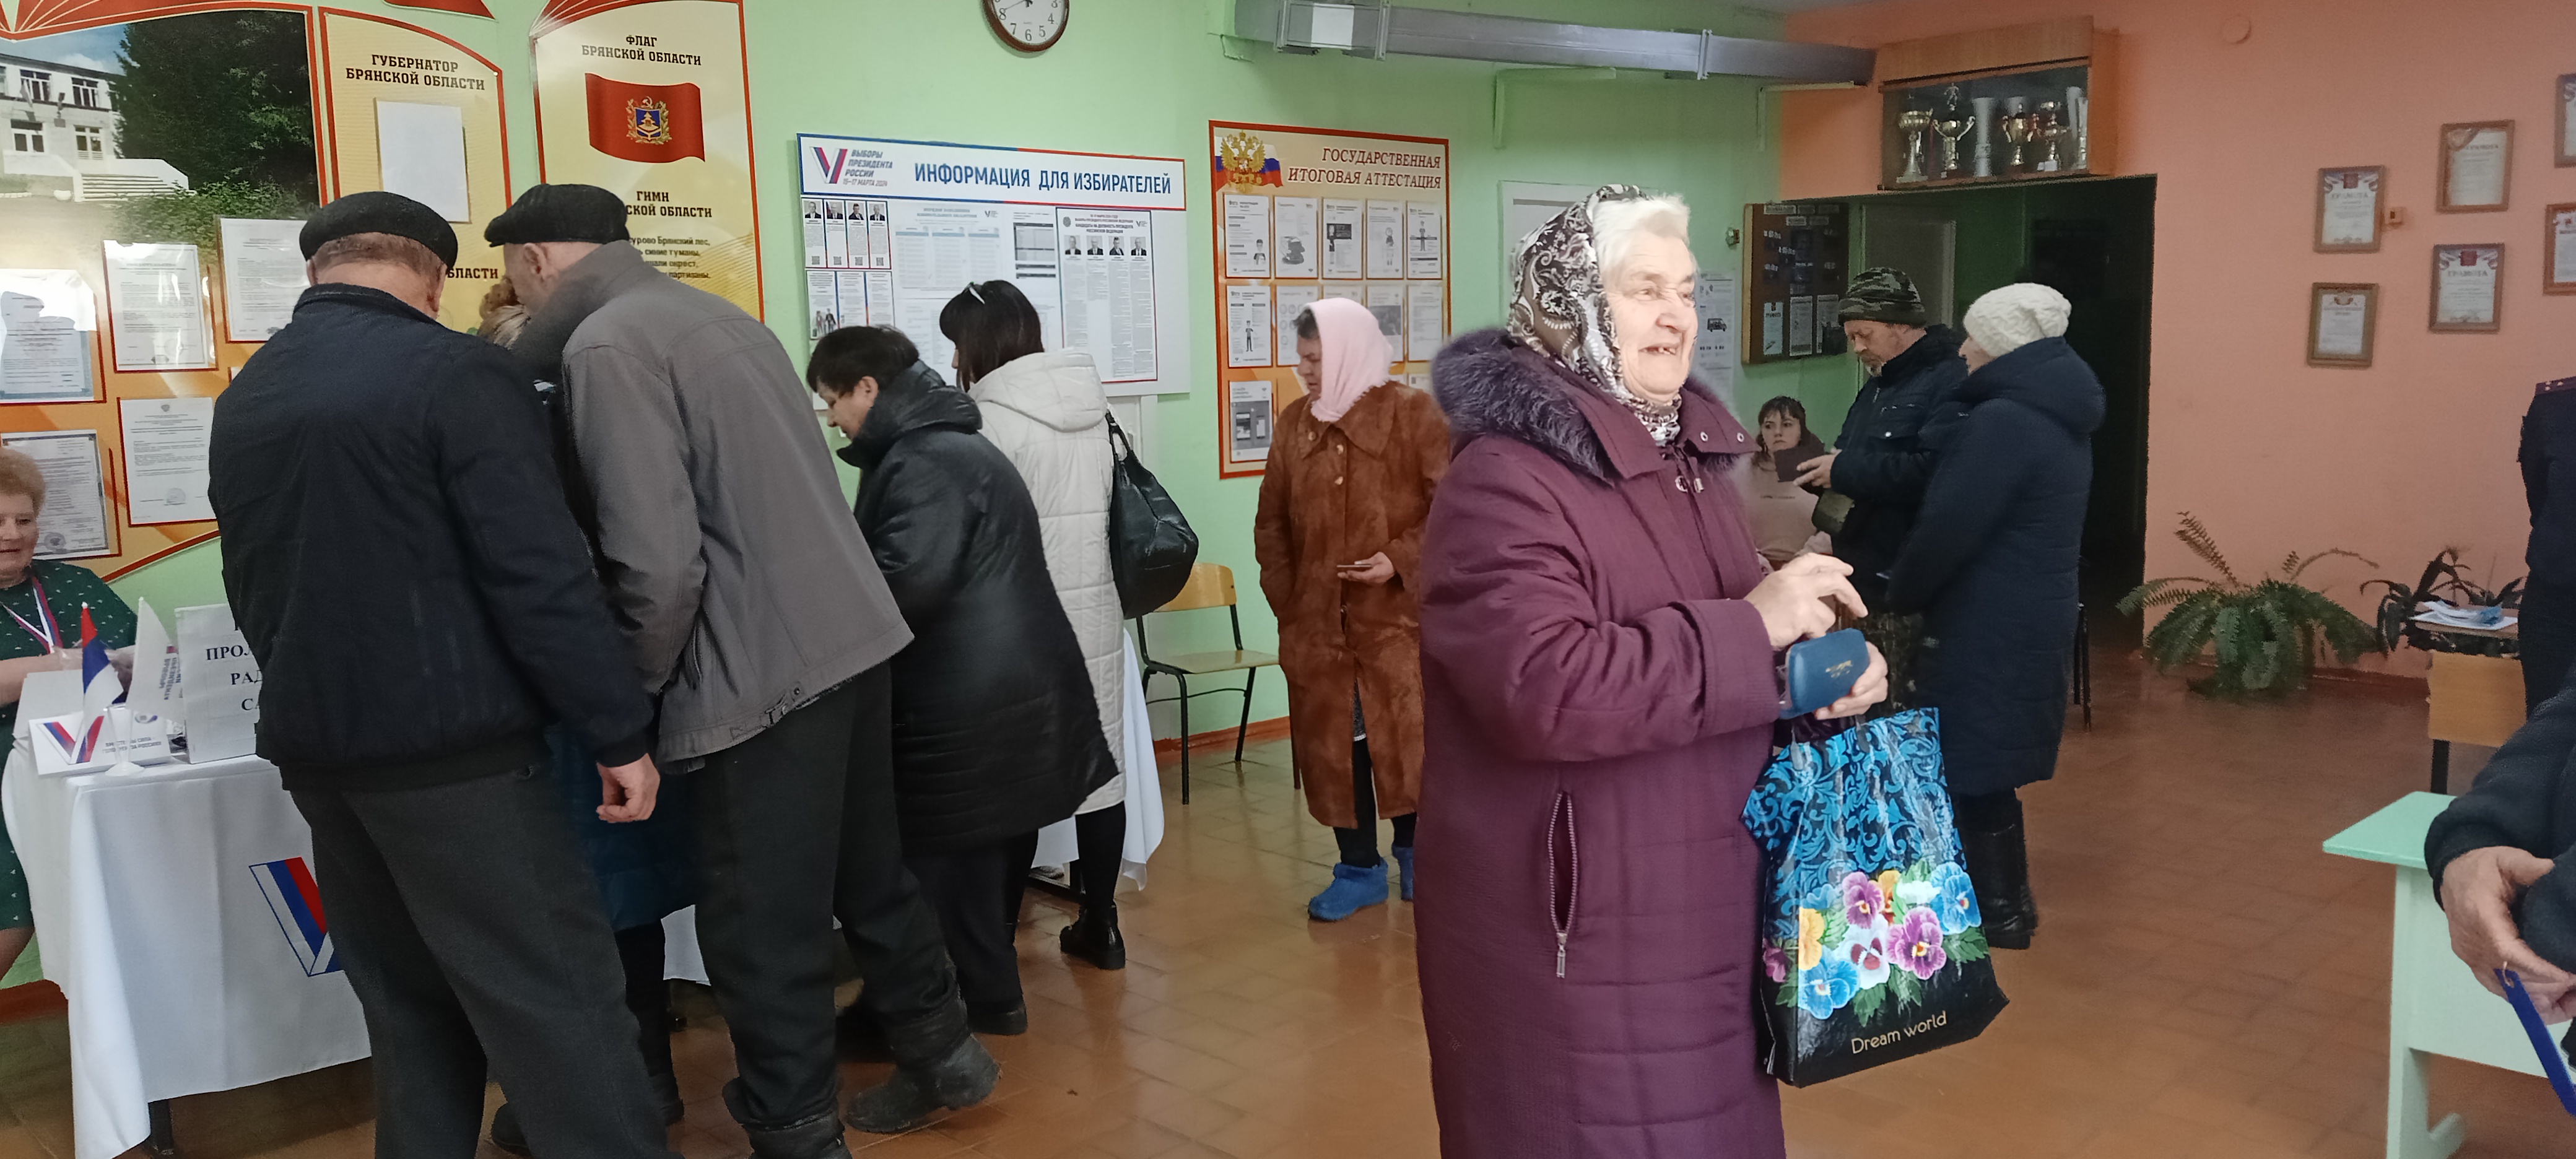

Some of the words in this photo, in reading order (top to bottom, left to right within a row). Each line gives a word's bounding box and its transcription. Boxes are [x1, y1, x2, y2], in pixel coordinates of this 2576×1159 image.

[999, 7, 1006, 20] 8
[1047, 12, 1055, 24] 4
[1010, 22, 1017, 35] 7
[1025, 28, 1032, 41] 6
[1039, 25, 1046, 37] 5
[625, 35, 657, 47] ФЛАГ
[581, 45, 645, 61] БРЯНСКОЙ
[649, 51, 702, 66] ОБЛАСТИ
[372, 54, 458, 72] ГУБЕРНАТОР
[346, 67, 419, 85] БРЯНСКОЙ
[424, 75, 485, 90] ОБЛАСТИ
[851, 149, 883, 158] ВЫБОРЫ
[1322, 148, 1441, 168] ГОСУДАРСТВЕННАЯ
[848, 159, 893, 168] ПРЕЗИДЕНТА
[845, 169, 874, 178] РОССИИ
[915, 163, 1030, 188] ИНФОРМАЦИЯ
[1038, 170, 1068, 191] ДЛЯ
[1074, 172, 1171, 194] ИЗБИРАТЕЛЕЙ
[1288, 168, 1361, 184] ИТОГОВАЯ
[1364, 172, 1441, 189] АТТЕСТАЦИЯ
[637, 191, 669, 202] ГИМН
[625, 204, 656, 215] СКОЙ
[660, 206, 712, 217] ОБЛАСТИ
[658, 237, 694, 246] Брянский
[447, 268, 498, 279] БЛАСТИ
[1852, 1031, 1901, 1054] Dream
[1904, 1010, 1947, 1038] world
